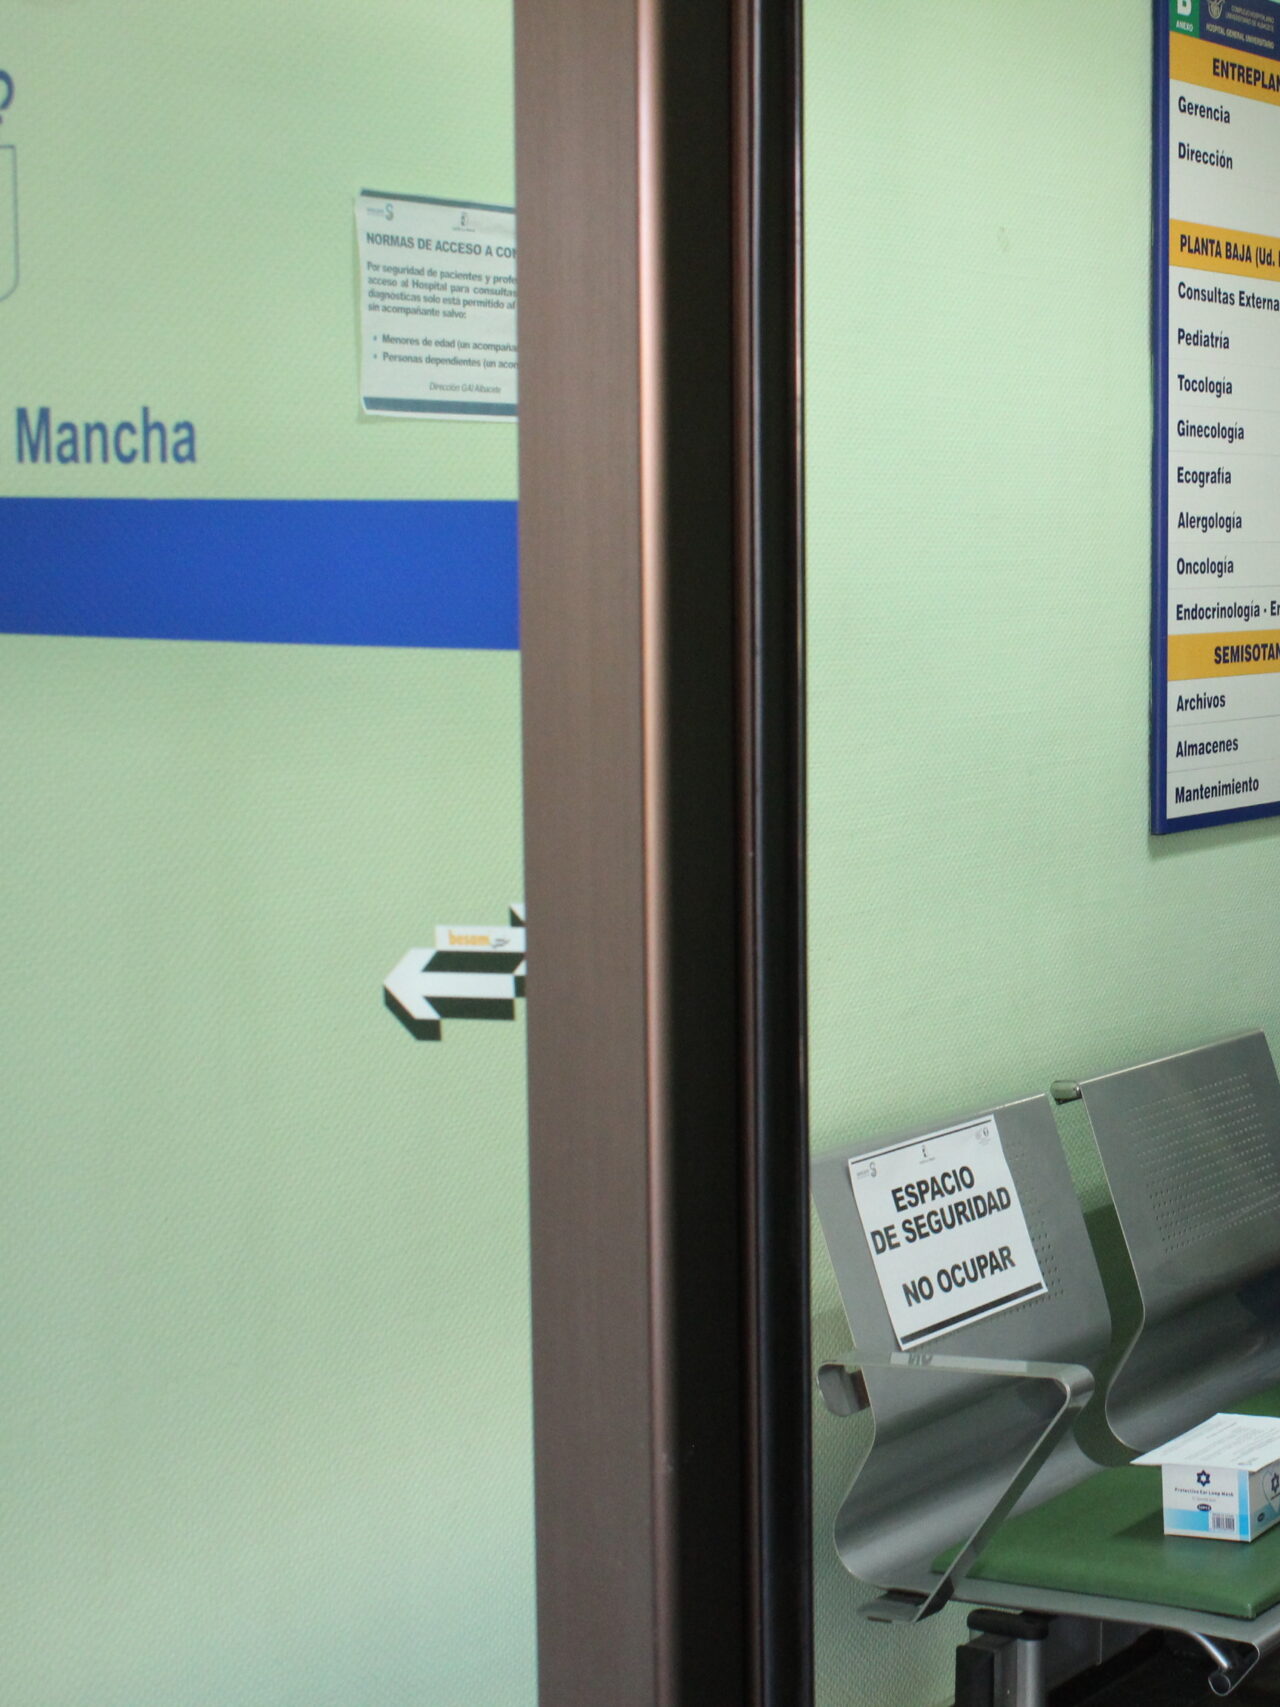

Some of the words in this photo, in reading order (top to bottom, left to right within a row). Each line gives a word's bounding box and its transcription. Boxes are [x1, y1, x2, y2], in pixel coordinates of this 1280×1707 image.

[1176, 20, 1194, 32] ANEXO
[1178, 96, 1231, 124] Gerencia
[1178, 142, 1234, 170] Dirección
[366, 232, 415, 249] NORMAS
[417, 238, 433, 251] DE
[435, 240, 482, 256] ACCESO
[485, 245, 493, 257] A
[1180, 234, 1222, 258] PLANTA
[1225, 242, 1252, 263] BAJA
[1255, 246, 1275, 269] (Ud.
[366, 261, 380, 272] Por
[382, 262, 425, 276] seguridad
[427, 266, 438, 277] de
[440, 268, 482, 283] pacientes
[484, 274, 490, 285] y
[367, 276, 397, 288] acceso
[401, 278, 409, 288] al
[412, 279, 447, 293] Hospital
[450, 283, 470, 294] para
[1177, 281, 1235, 307] Consultas
[368, 303, 380, 313] sin
[381, 304, 440, 318] acompañante
[462, 296, 505, 310] permitido
[382, 333, 420, 346] Menores
[422, 337, 433, 347] de
[434, 338, 456, 349] edad
[457, 340, 470, 351] (un
[1177, 328, 1230, 350] Pediatría
[382, 352, 423, 364] Personas
[425, 354, 481, 367] dependientes
[483, 357, 496, 369] (un
[1177, 374, 1233, 398] Tocología
[16, 406, 196, 464] Mancha
[1177, 420, 1245, 443] Ginecología
[1177, 466, 1232, 488] Ecografía
[1177, 511, 1242, 533] Alergología
[1176, 556, 1234, 578] Oncología
[1176, 600, 1260, 622] Endocrinología
[1176, 692, 1226, 712] Archivos
[1175, 737, 1239, 758] Almacenes
[1175, 776, 1260, 804] Mantenimiento
[891, 1166, 975, 1213] ESPACIO
[870, 1225, 901, 1255] DE
[901, 1187, 1012, 1244] SEGURIDAD
[902, 1276, 934, 1307] NO
[936, 1246, 1016, 1293] OCUPAR
